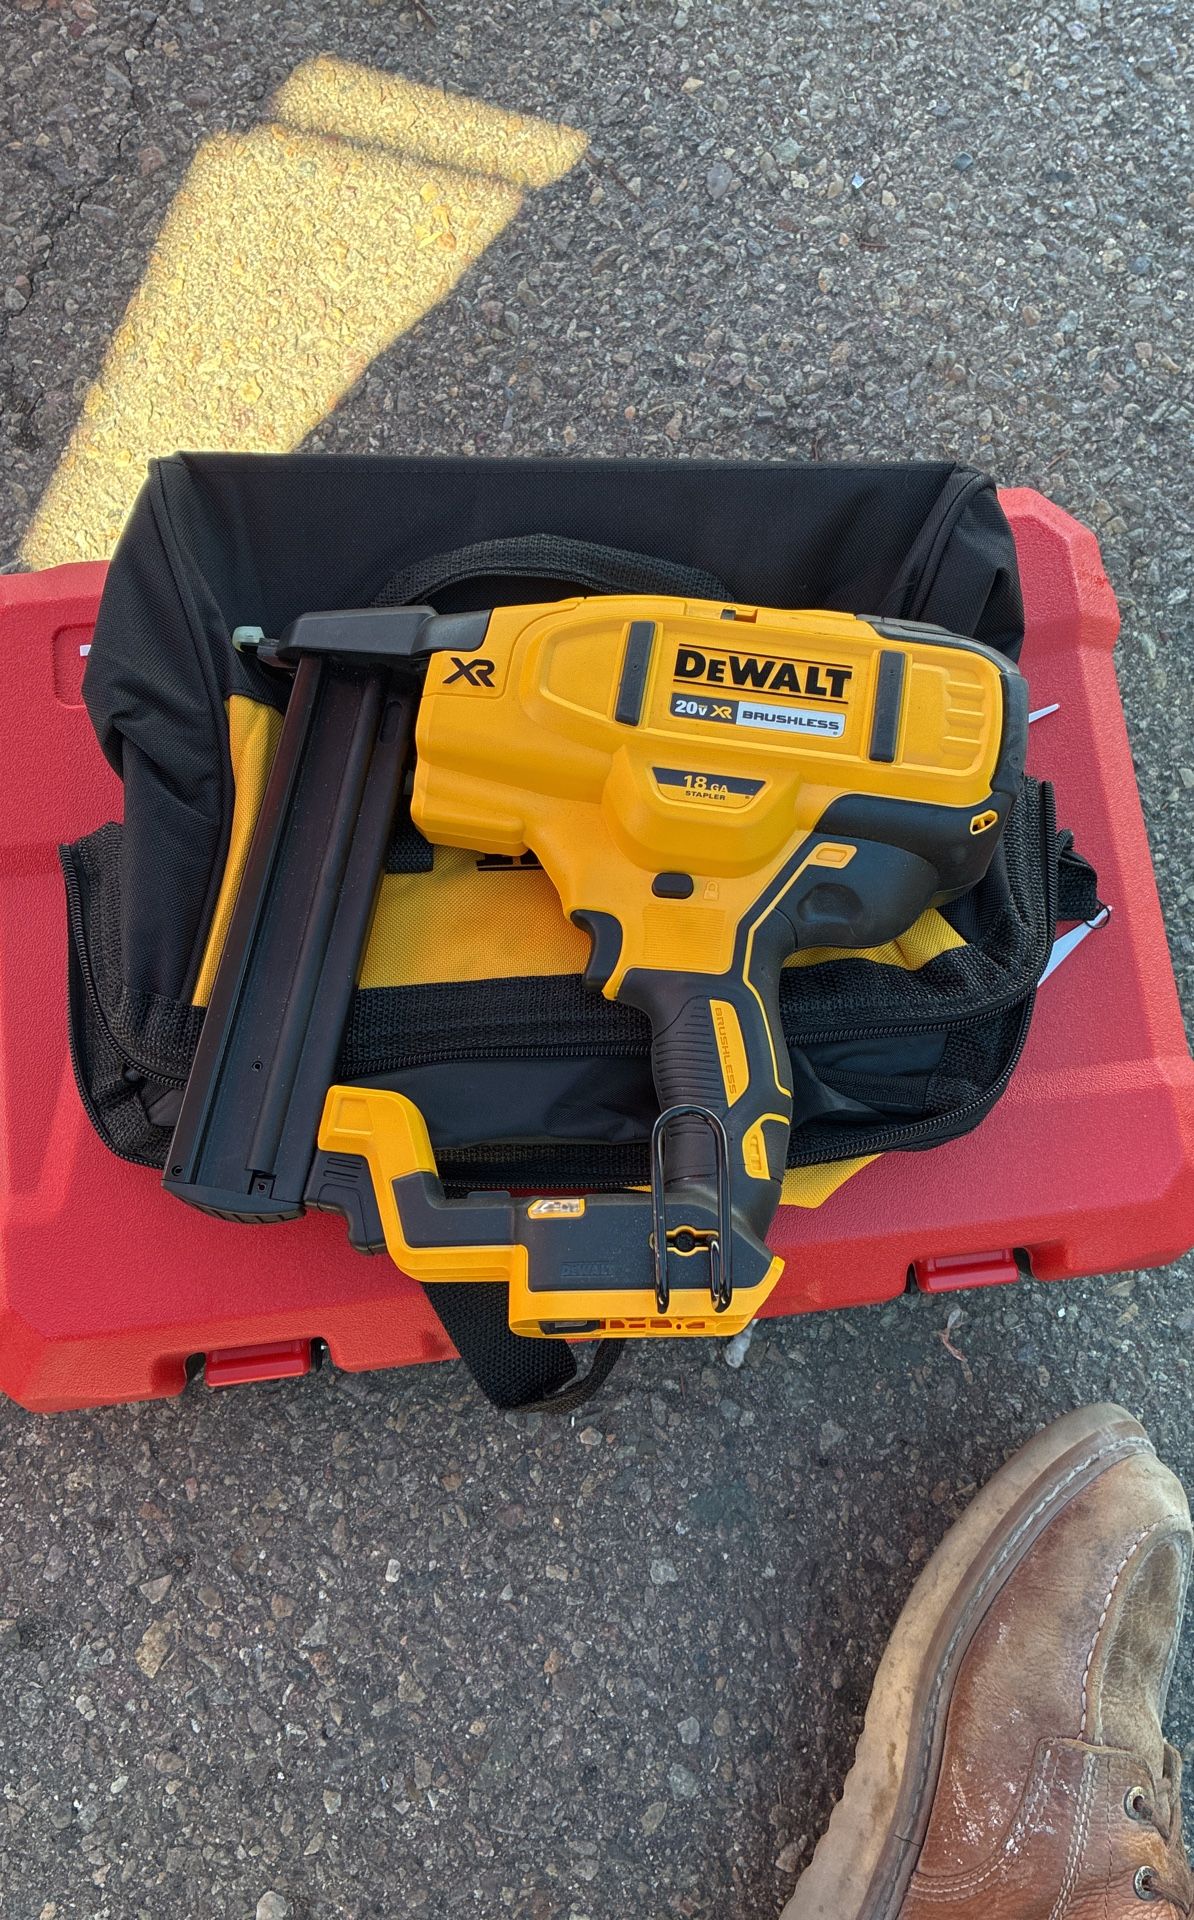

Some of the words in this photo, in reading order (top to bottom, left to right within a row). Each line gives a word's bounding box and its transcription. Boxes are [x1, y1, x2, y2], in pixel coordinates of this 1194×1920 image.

[442, 657, 496, 687] XR
[674, 648, 853, 698] DEWALT
[709, 704, 733, 719] XR
[742, 710, 839, 730] BRUSHLESS
[683, 775, 708, 790] 18
[710, 783, 729, 793] GA
[685, 790, 726, 801] STAPLER
[715, 1007, 737, 1094] BRUSHLESS
